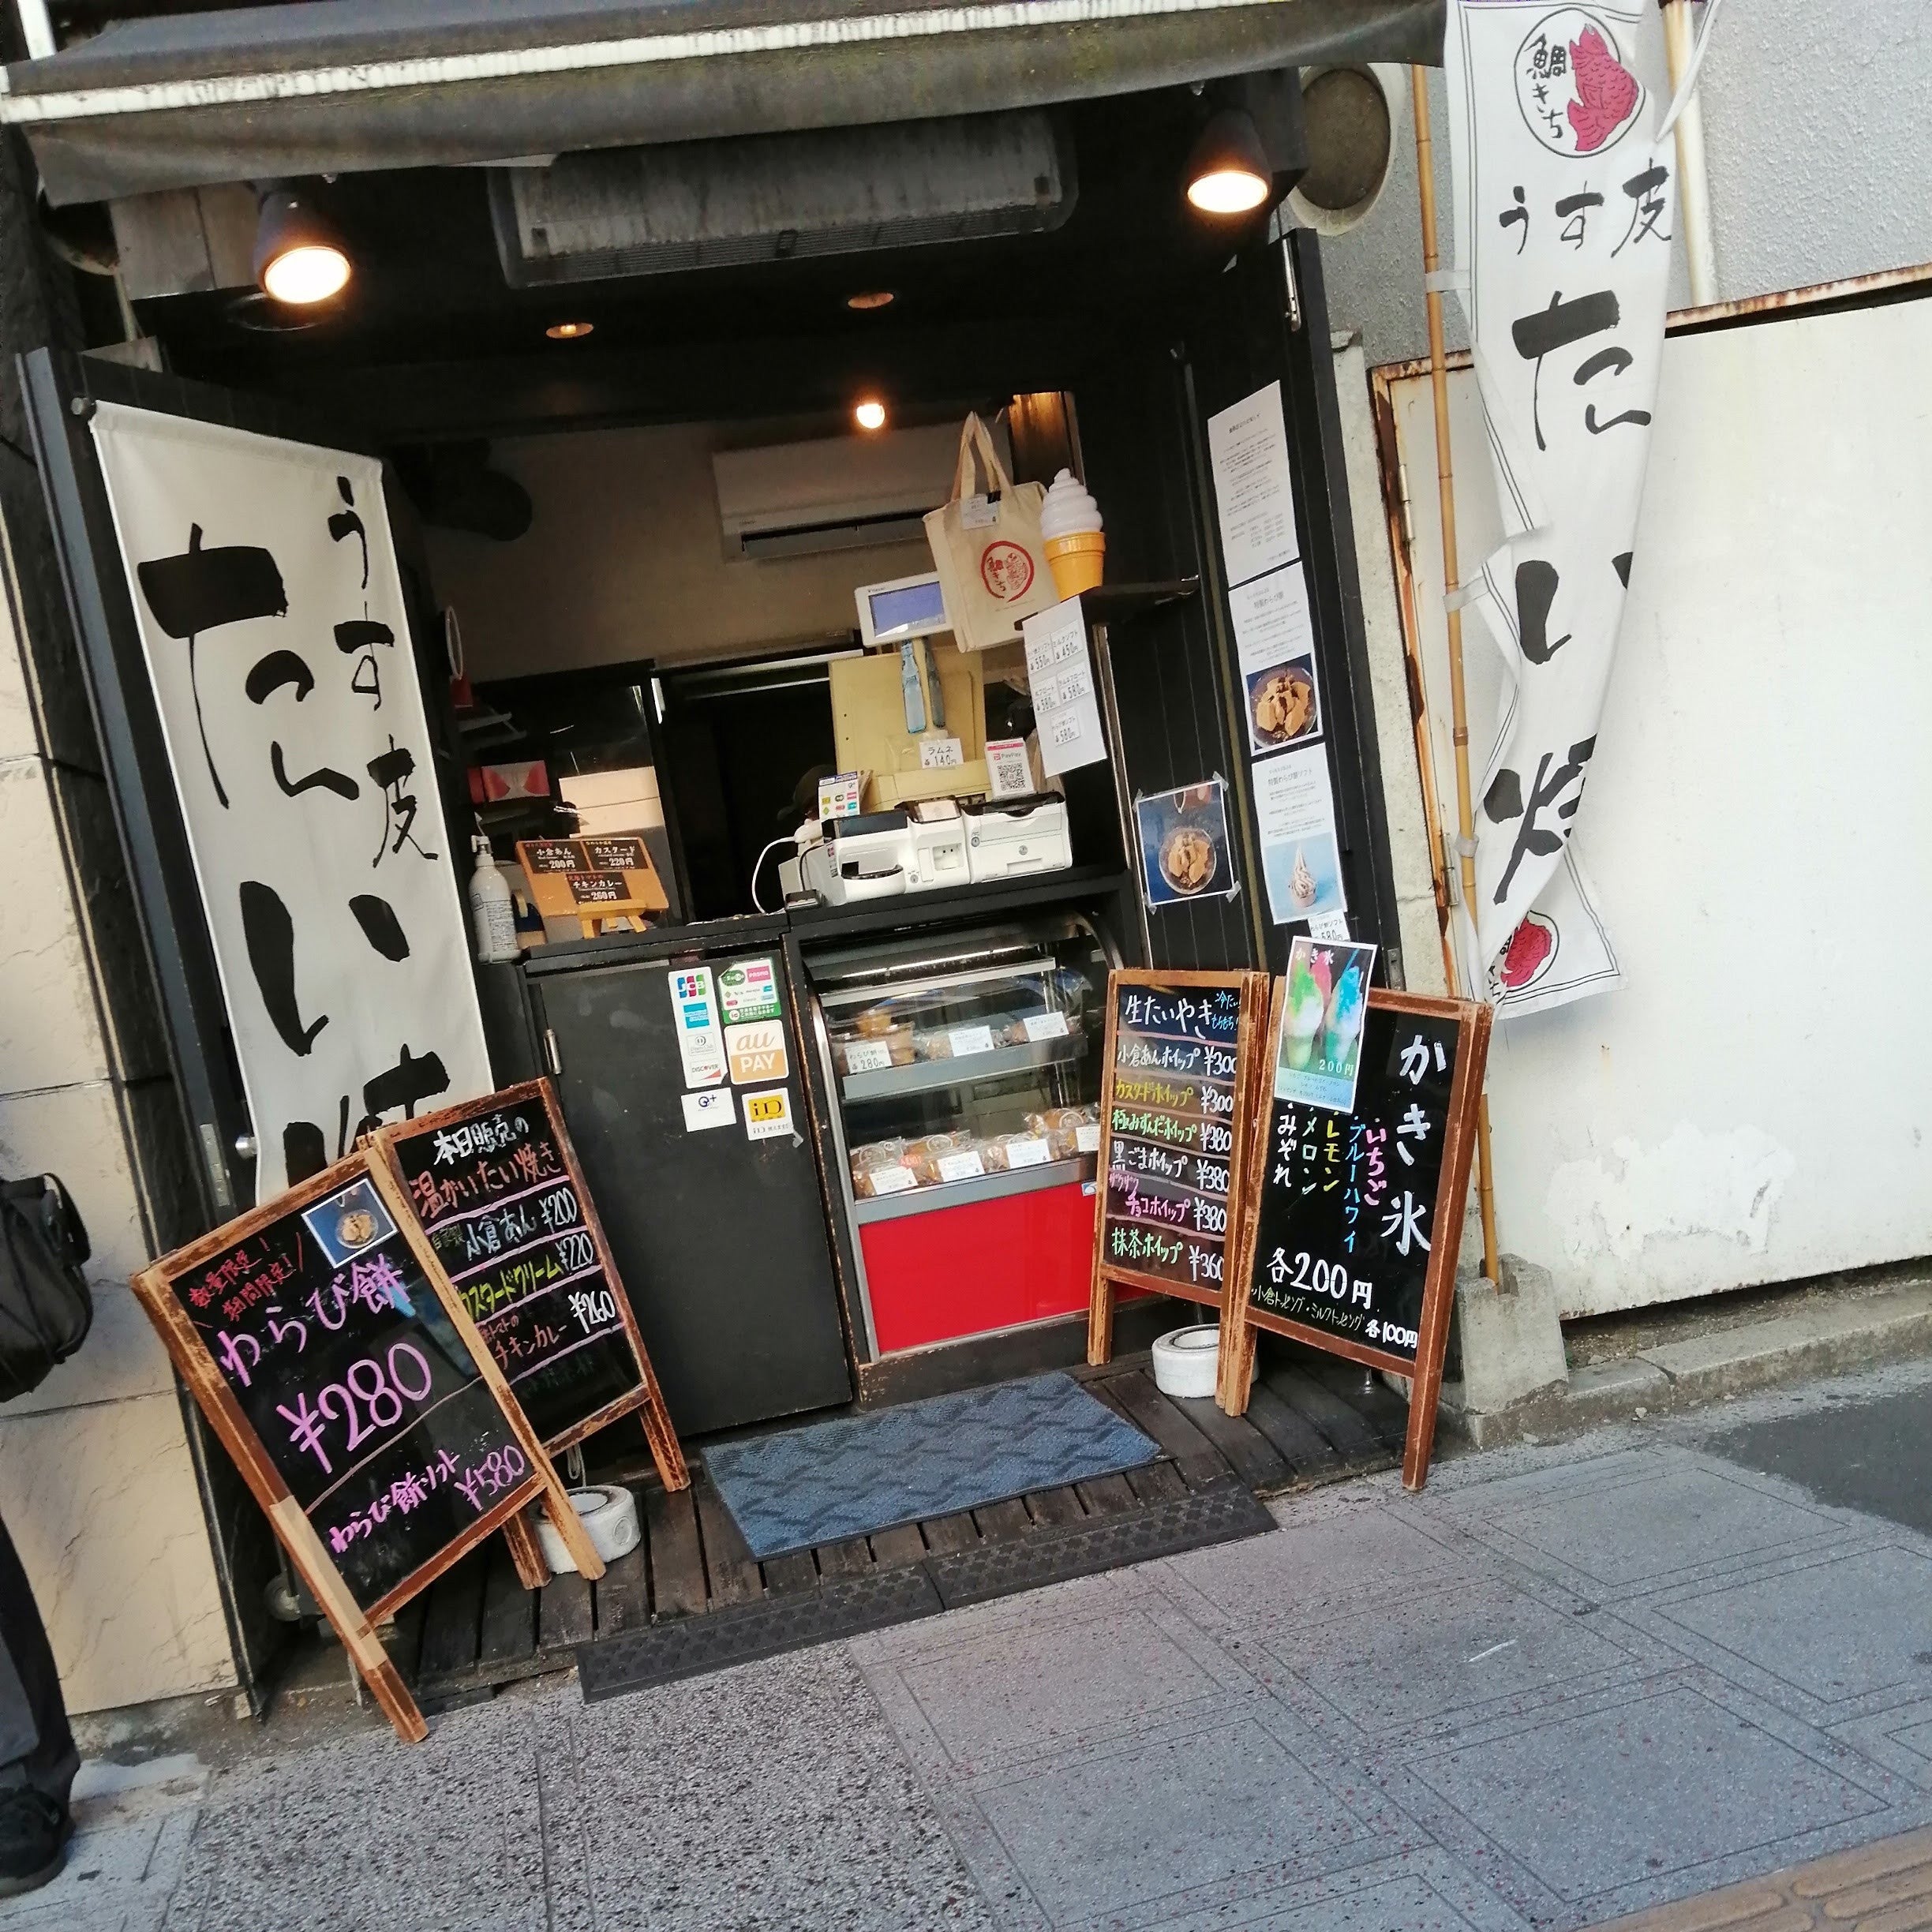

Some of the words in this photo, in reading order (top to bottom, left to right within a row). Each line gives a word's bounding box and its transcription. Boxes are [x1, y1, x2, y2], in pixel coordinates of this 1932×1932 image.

[1525, 33, 1567, 139] 鯛きち
[1499, 157, 1672, 258] うす皮
[327, 475, 438, 868] うす皮
[928, 746, 953, 755] ラムネ
[549, 859, 575, 869] 200円
[594, 845, 635, 855] カスタード
[608, 857, 635, 867] 220円
[573, 879, 623, 889] チキンカレー
[590, 891, 617, 900] 260円
[1295, 948, 1335, 965] かき氷
[677, 977, 706, 994] JCB
[1125, 994, 1213, 1039] 生たいやき
[736, 1031, 776, 1050] au
[1117, 1044, 1202, 1070] 小倉あんホイップ
[1204, 1046, 1237, 1076] ¥300
[691, 1064, 719, 1073] DISCOVER
[739, 1053, 776, 1073] PAY
[1319, 1058, 1362, 1077] 200円
[754, 1099, 782, 1116] iD
[1200, 1085, 1233, 1114] ¥300
[433, 1114, 530, 1166] 本日販売の
[1200, 1122, 1232, 1152] ¥380
[1380, 1034, 1447, 1256] かき氷
[409, 1141, 562, 1219] 温かいたい焼き
[1111, 1140, 1188, 1178] 黒ごまホイップ
[1196, 1159, 1230, 1191] ¥380
[466, 1204, 537, 1261] 小倉あん
[540, 1186, 578, 1234] ¥200
[1125, 1193, 1191, 1222] チョコホイップ
[1193, 1197, 1226, 1232] ¥380
[555, 1231, 594, 1275] ¥220
[1110, 1227, 1183, 1264] 抹茶ホイップ
[1189, 1245, 1223, 1282] ¥360
[1266, 1246, 1373, 1310] 各200円
[216, 1252, 412, 1387] わらび餅
[494, 1324, 567, 1370] チキンカレー
[568, 1289, 616, 1335] ¥260
[1365, 1318, 1418, 1350] 各100円
[275, 1342, 433, 1474] ¥280
[453, 1443, 526, 1511] ¥580
[328, 1448, 461, 1554] わらび餅ソフト
